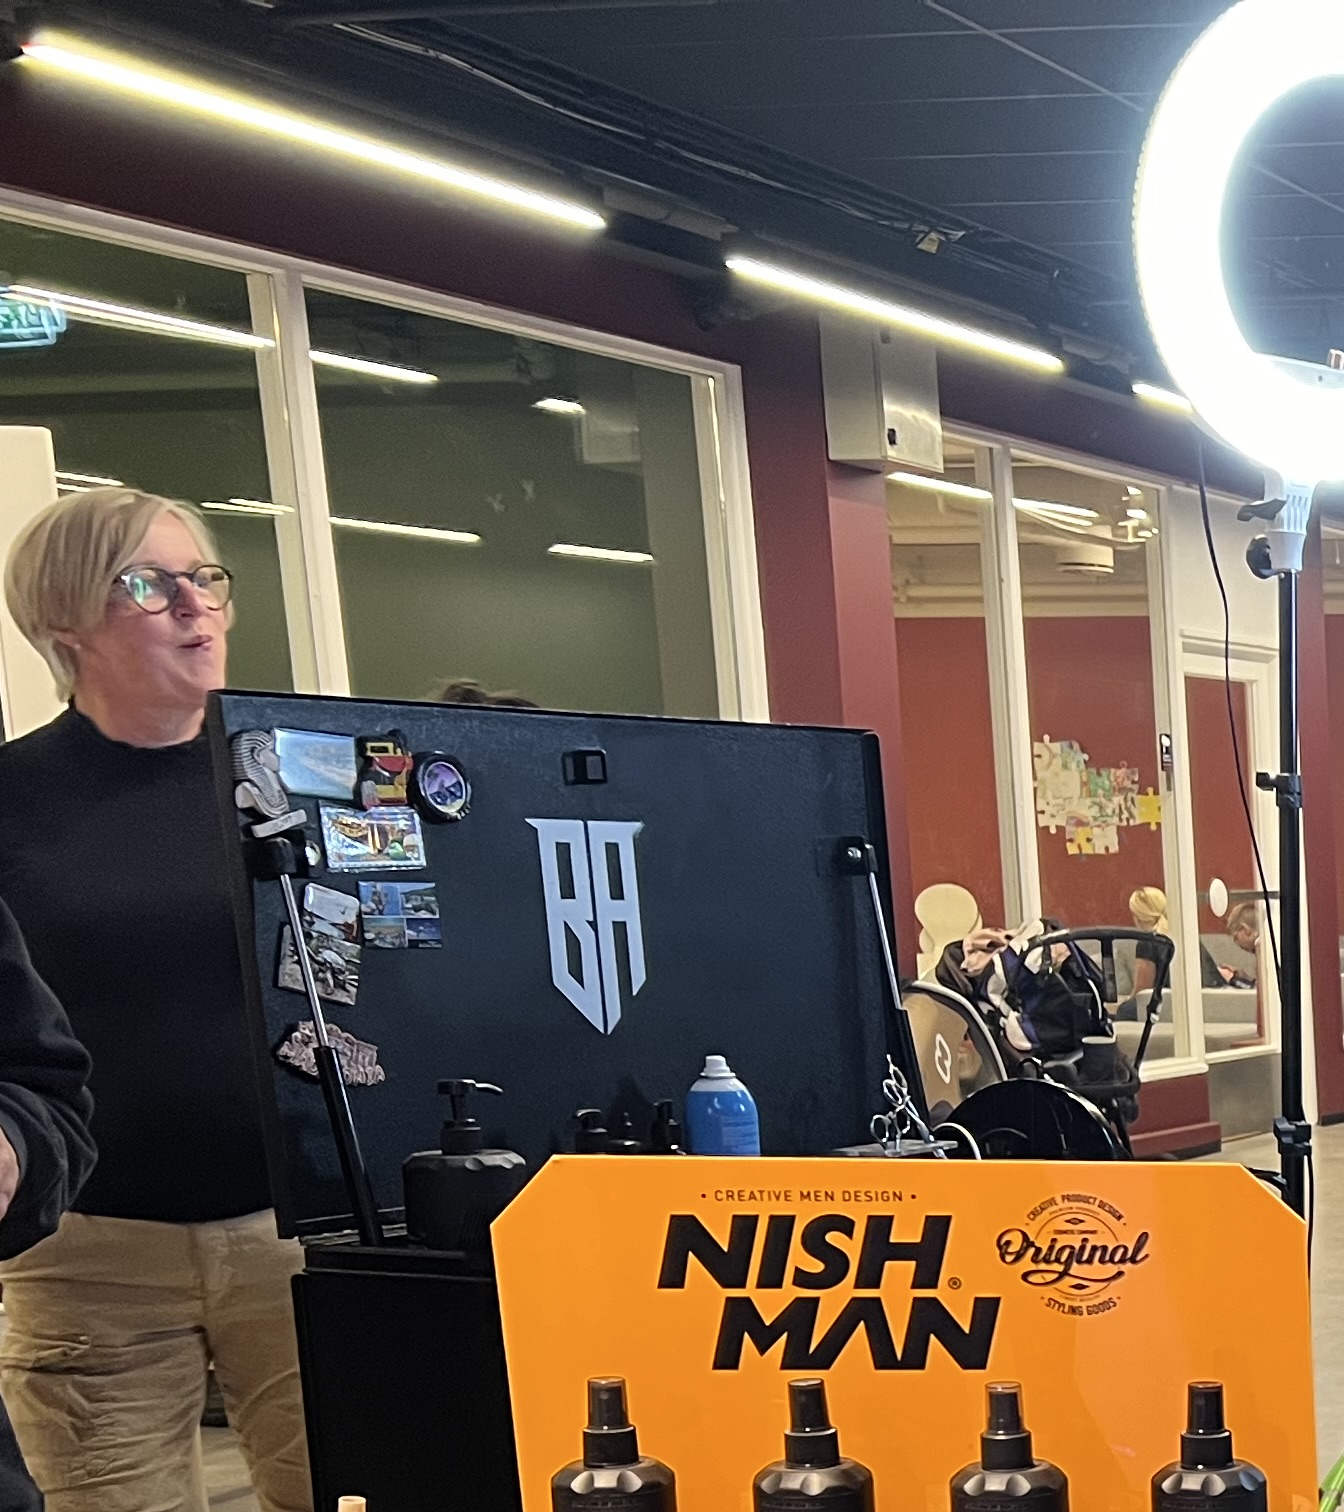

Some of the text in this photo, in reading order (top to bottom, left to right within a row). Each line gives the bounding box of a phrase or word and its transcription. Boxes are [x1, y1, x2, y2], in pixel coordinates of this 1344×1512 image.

[714, 1189, 904, 1203] CREATIVE MEN DESIGN
[657, 1214, 953, 1290] NISH
[995, 1228, 1150, 1287] Original
[712, 1296, 1002, 1371] MAN
[1044, 1297, 1084, 1316] STYLING
